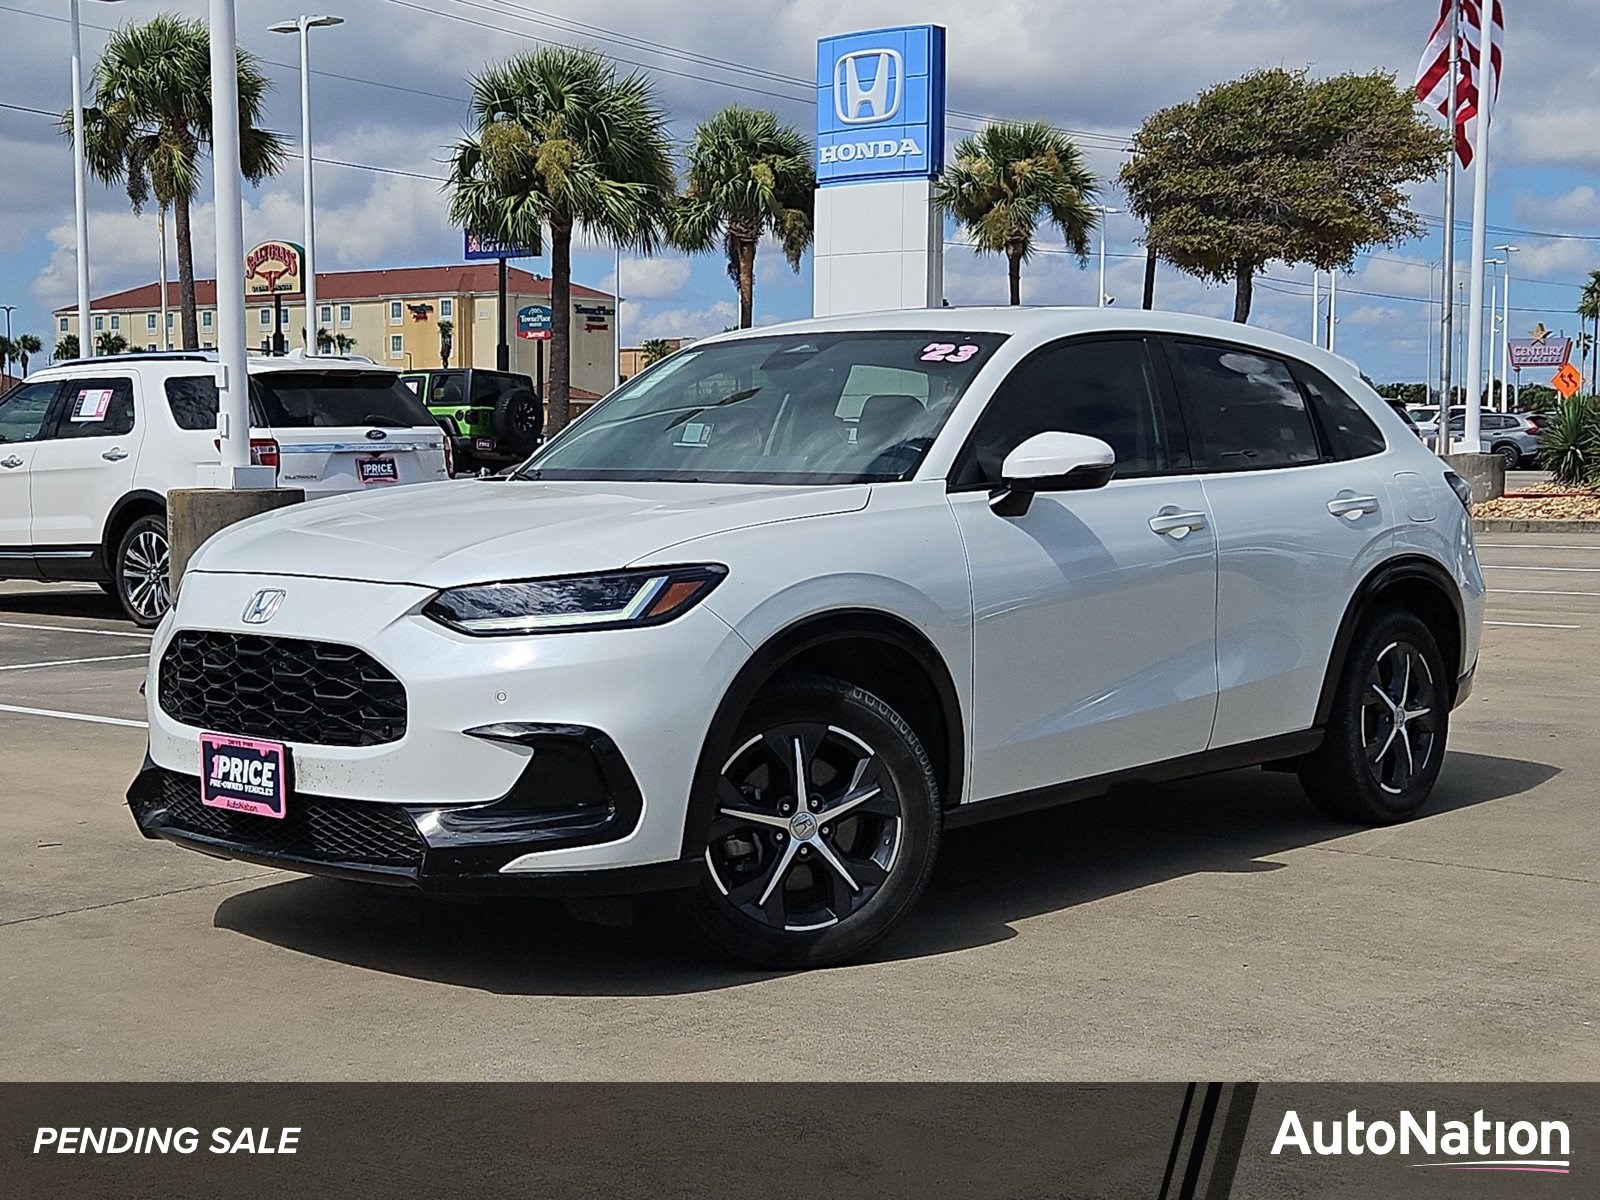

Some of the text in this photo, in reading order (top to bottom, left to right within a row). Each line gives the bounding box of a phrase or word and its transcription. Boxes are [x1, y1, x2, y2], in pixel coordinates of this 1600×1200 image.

[819, 138, 922, 164] HONDA
[1515, 346, 1564, 357] CENTURY
[209, 778, 274, 797] PRE-OWNED VEHICLES
